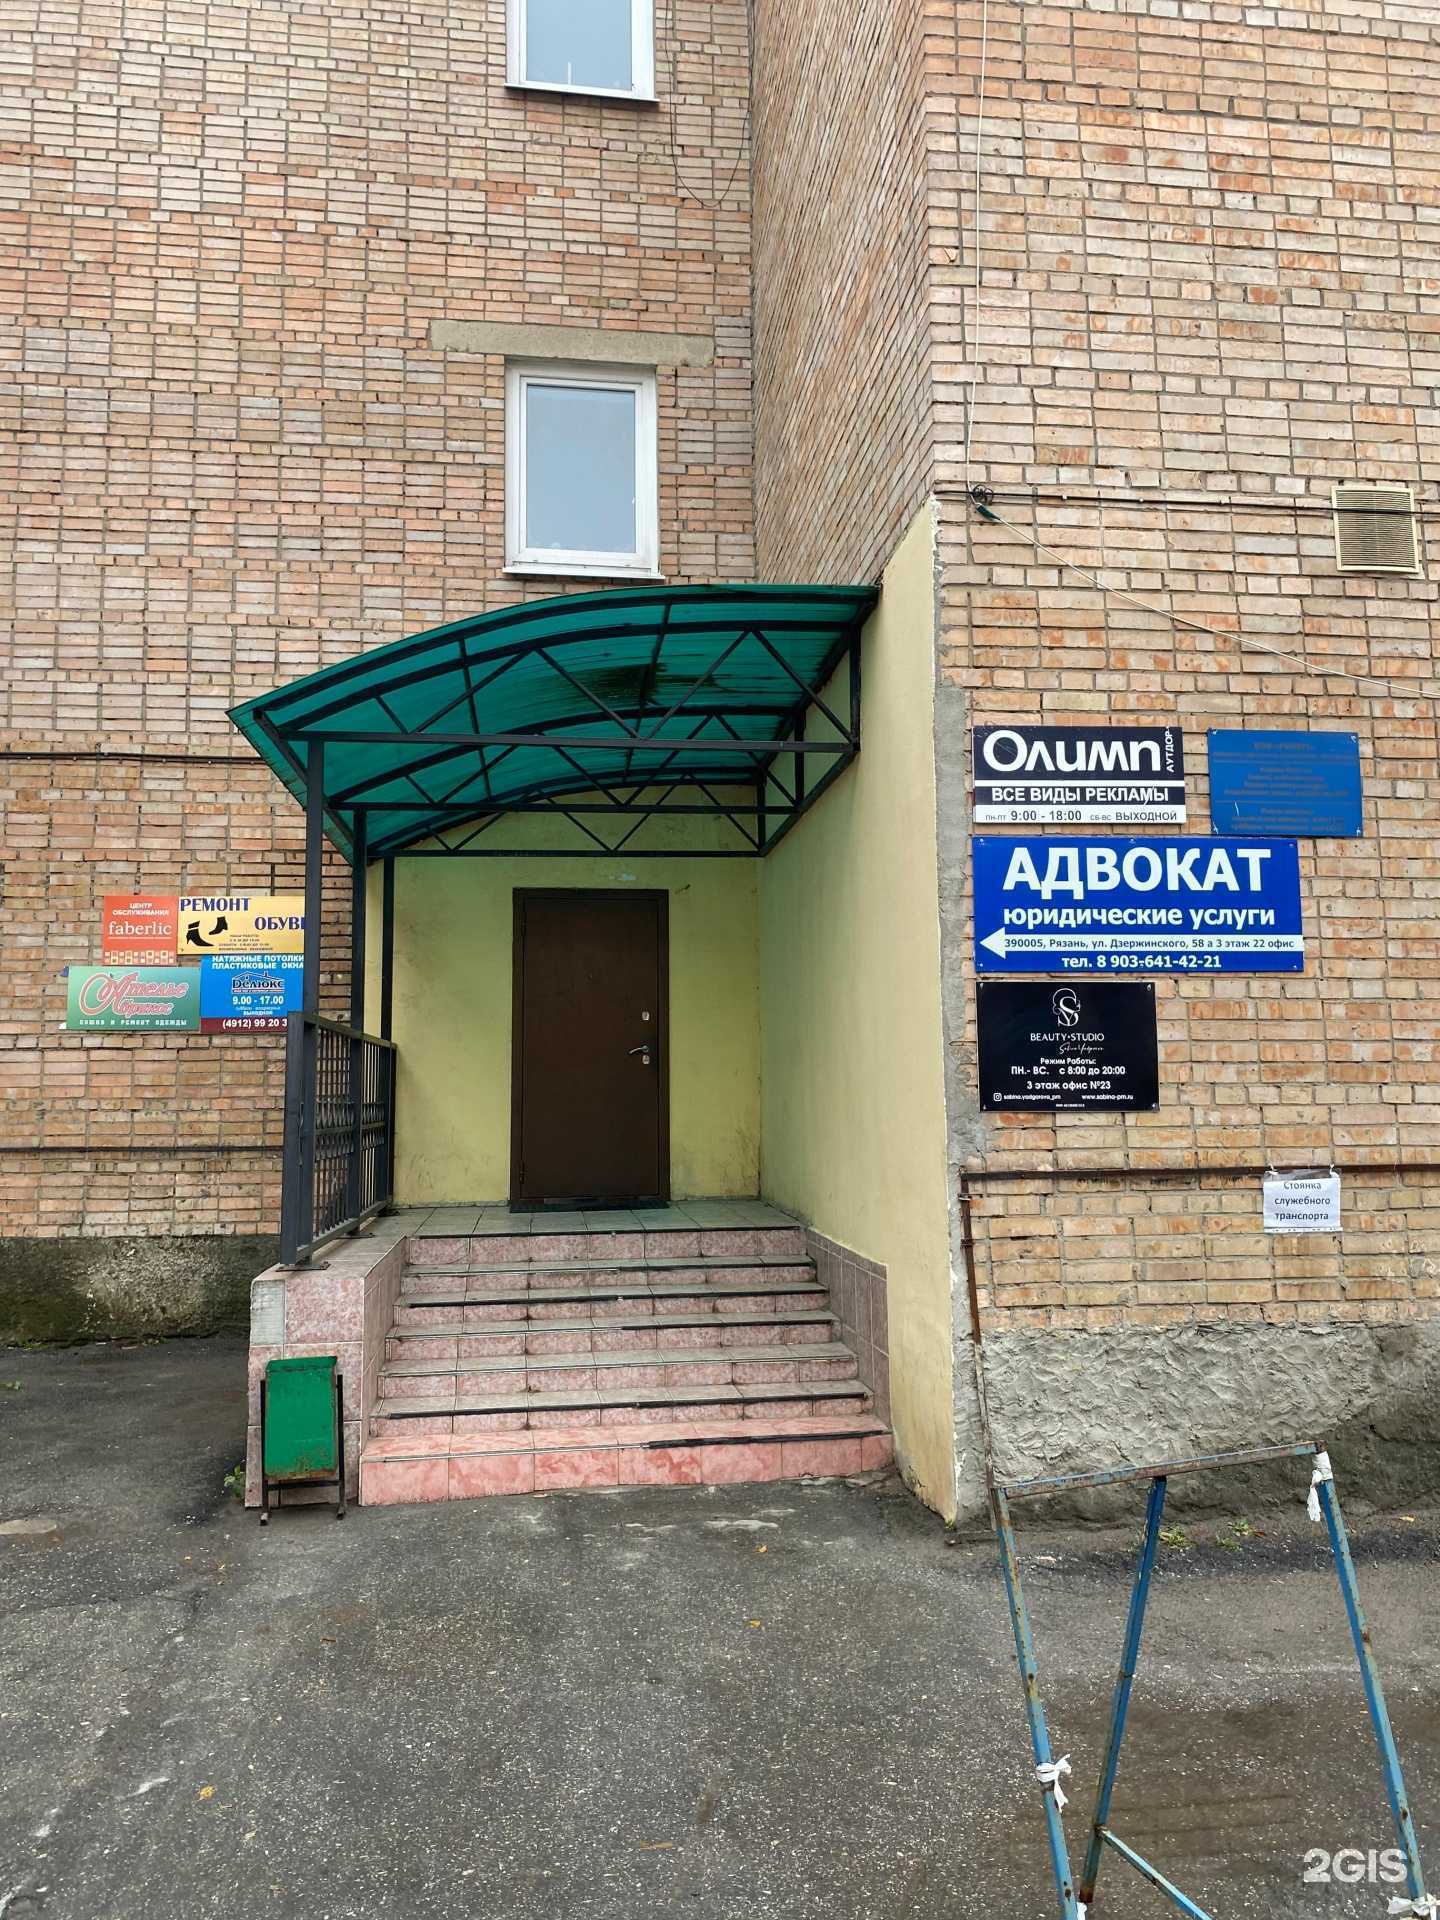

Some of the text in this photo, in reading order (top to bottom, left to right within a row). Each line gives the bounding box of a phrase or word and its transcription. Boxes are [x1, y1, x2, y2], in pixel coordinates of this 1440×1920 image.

[983, 730, 1161, 772] Олимп
[992, 787, 1169, 804] ВСЕ ВИДЫ РЕКЛАМЫ
[1010, 810, 1037, 821] 9:00
[1049, 810, 1082, 821] 18:00
[1115, 811, 1177, 822] ВЫХОДНОЙ
[1002, 847, 1271, 900] АДВОКАТ
[180, 898, 251, 912] РЕМОНТ
[1004, 907, 1275, 930] юридические услуги
[109, 921, 172, 935] faberlic
[1004, 938, 1046, 949] 390005,
[1049, 938, 1089, 949] Рязань,
[1092, 941, 1108, 949] ул.
[1110, 938, 1189, 949] Дзержинского,
[1192, 938, 1204, 948] 58
[1216, 938, 1222, 948] 3
[1253, 939, 1265, 948] 22
[1268, 938, 1294, 950] офис
[1062, 955, 1222, 968] тел. 8 903-641-42-21
[232, 996, 252, 1005] 9.00
[260, 996, 284, 1005] 17.00
[223, 1019, 252, 1029] (4912)
[254, 1019, 265, 1027] 99
[267, 1019, 279, 1027] 20
[1040, 1057, 1065, 1065] Режим
[1033, 1065, 1050, 1075] ВС.
[1067, 1065, 1086, 1075] 8:00
[1088, 1067, 1100, 1076] до
[1102, 1065, 1126, 1075] 20:00
[1026, 1080, 1111, 1091] 3 этаж офис №23
[1283, 1181, 1322, 1190] Стоянка
[1274, 1196, 1331, 1206] служебного
[1275, 1213, 1329, 1222] транспорта
